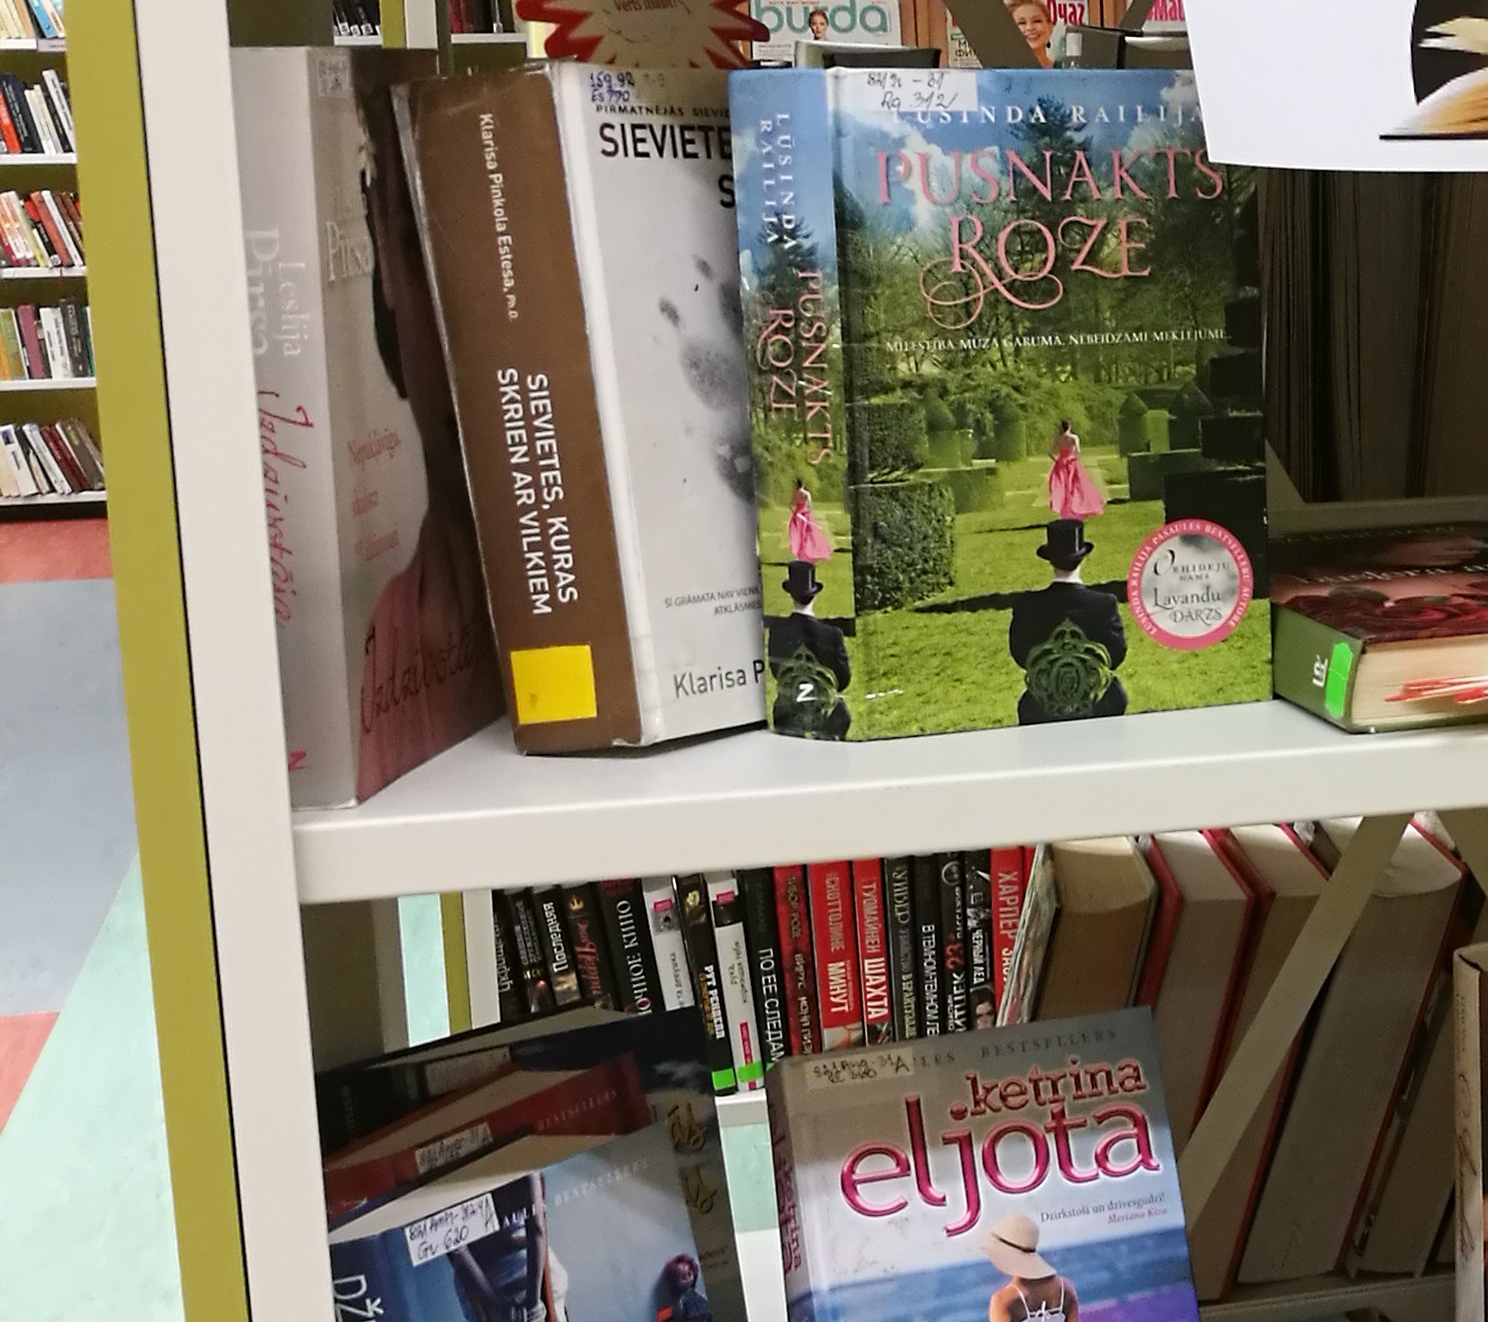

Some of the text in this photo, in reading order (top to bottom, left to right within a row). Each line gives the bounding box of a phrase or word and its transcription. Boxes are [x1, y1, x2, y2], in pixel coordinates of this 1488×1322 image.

[478, 112, 518, 293] Klarisa Pinkola Estesa,
[759, 117, 778, 247] RAILIJA
[776, 112, 795, 253] LŪSINDA
[876, 147, 1224, 205] PUSNAKTS
[919, 214, 1153, 331] ROZE
[756, 306, 798, 421] ROZE
[797, 269, 836, 468] PUSNAKTS
[497, 367, 553, 615] SKRIEN AR VILKIEM
[526, 373, 579, 605] SIEVIETES, KURAS
[673, 665, 747, 699] Klarisa
[616, 899, 640, 952] КИНО
[758, 947, 777, 996] ПО ЕЕ
[827, 960, 850, 1014] МИНУТ
[863, 956, 890, 1020] ШАХТА
[966, 1055, 1148, 1118] ketrina
[839, 1095, 1161, 1238] eljota
